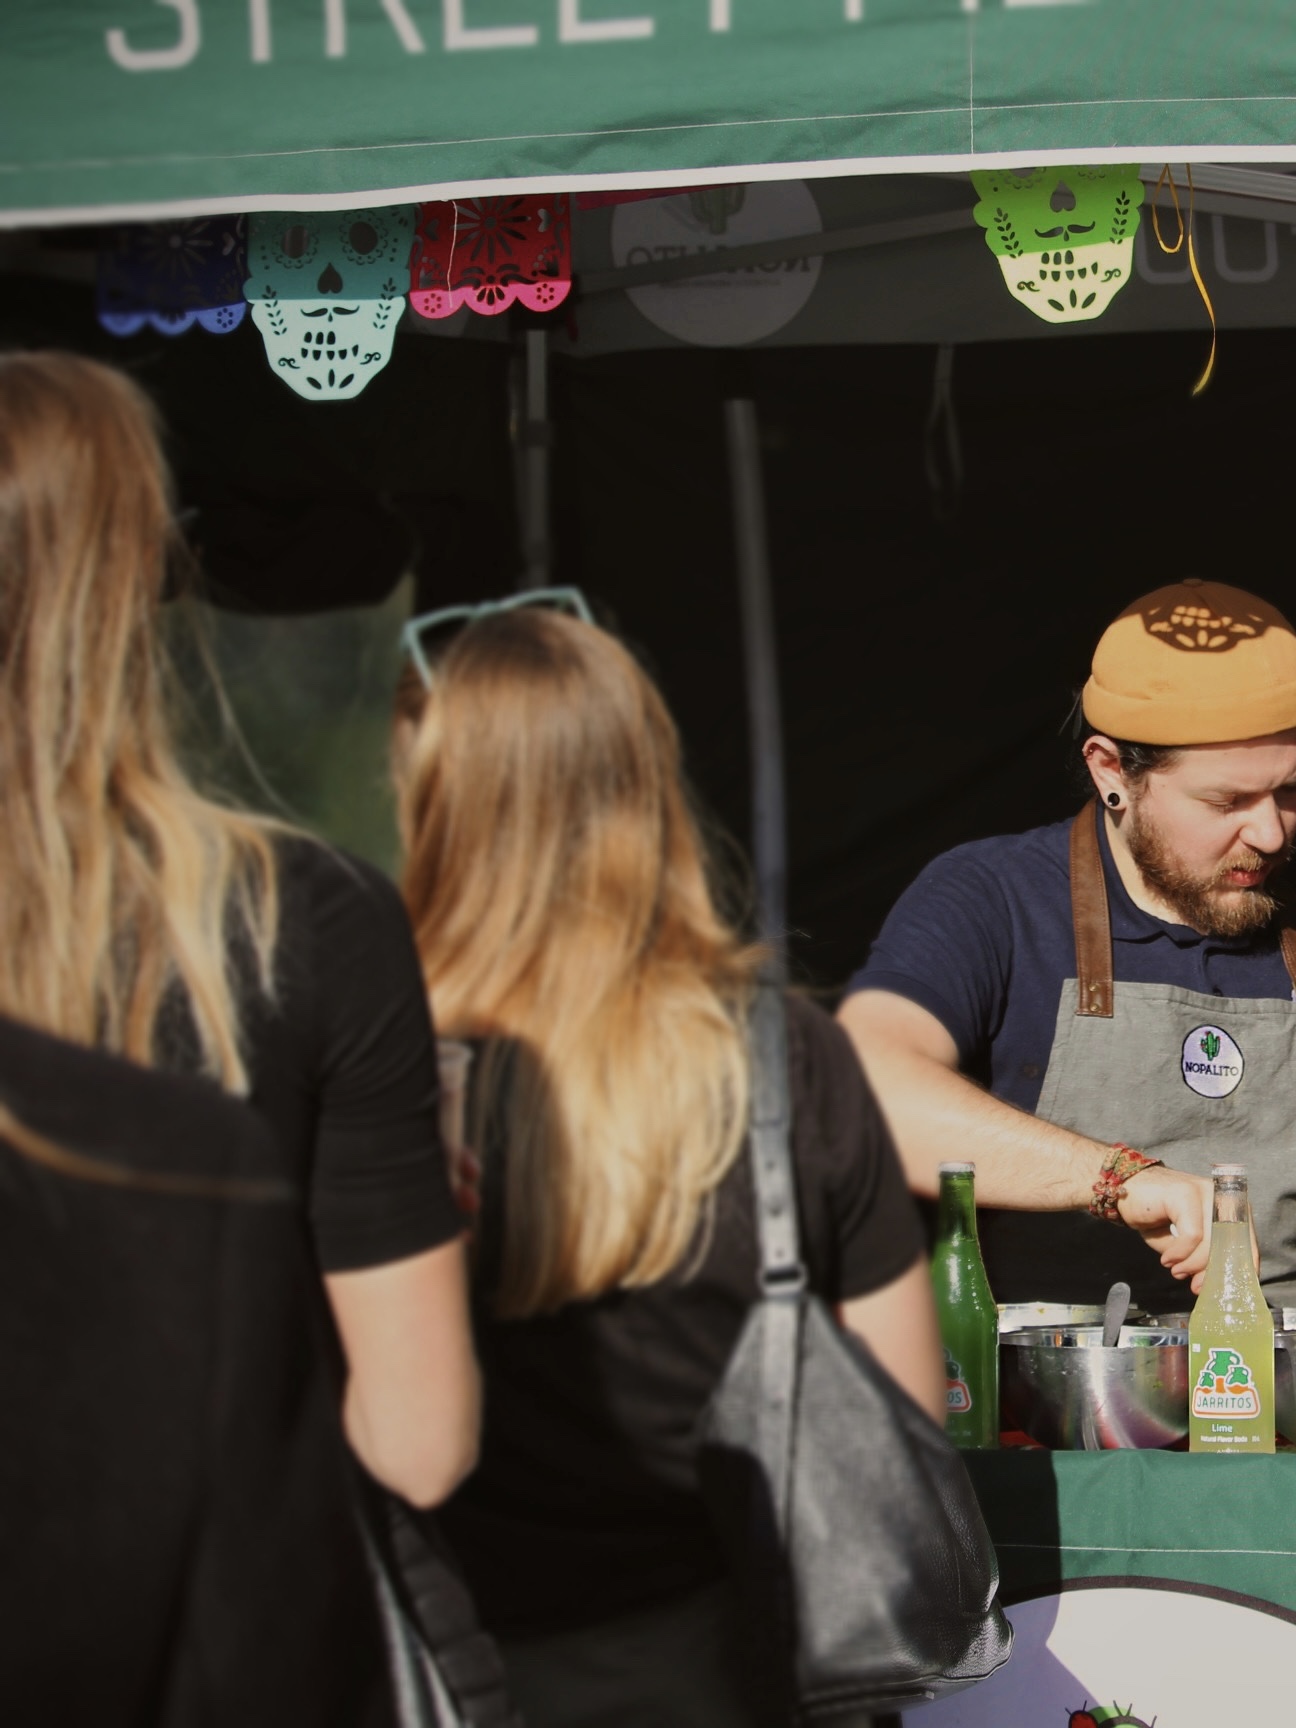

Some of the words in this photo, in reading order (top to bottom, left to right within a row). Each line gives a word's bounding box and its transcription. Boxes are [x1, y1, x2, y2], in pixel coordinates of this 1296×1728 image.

[1185, 1061, 1239, 1077] NOPALITO
[947, 1391, 962, 1403] OS
[1197, 1396, 1252, 1409] JARRITOS
[1212, 1423, 1233, 1433] Lime
